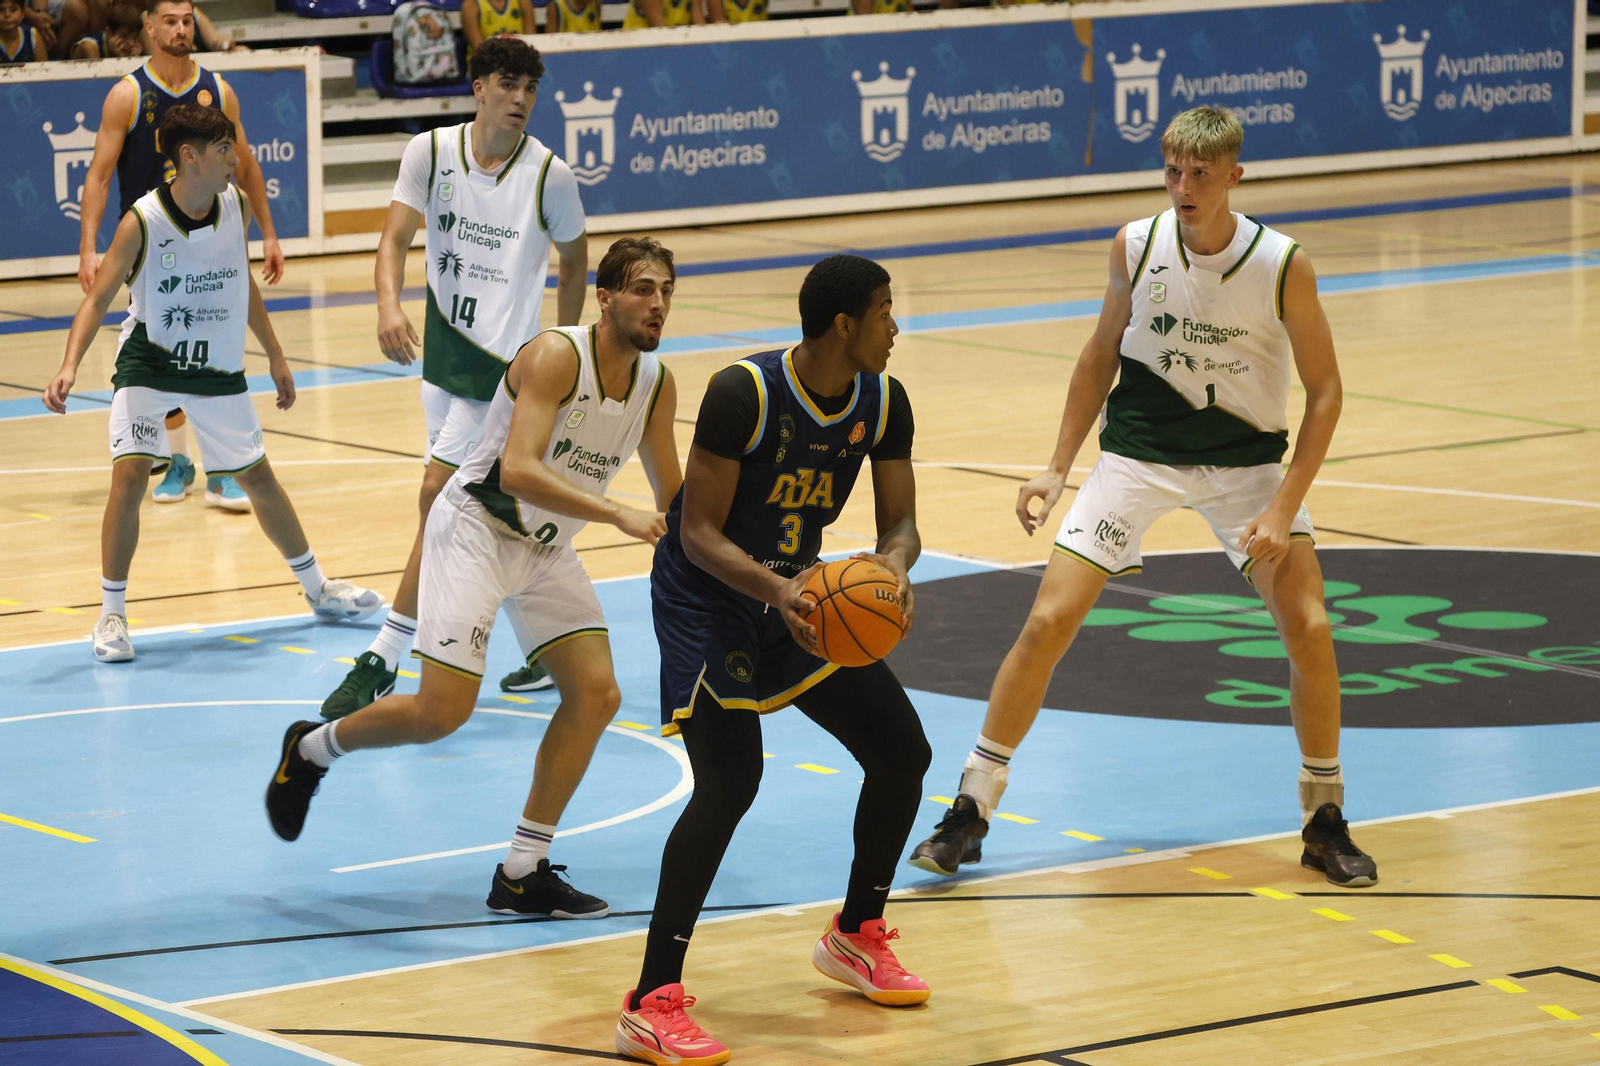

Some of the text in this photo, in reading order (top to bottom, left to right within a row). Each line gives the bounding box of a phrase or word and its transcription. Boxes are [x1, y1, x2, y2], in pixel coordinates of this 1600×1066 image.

[1435, 47, 1564, 83] Ayuntamiento
[1171, 66, 1308, 103] Ayuntamiento
[1434, 80, 1553, 113] de Algeciras
[922, 85, 1065, 122] Ayuntamiento
[629, 106, 780, 144] Ayuntamiento
[922, 118, 1052, 153] de Algeciras
[629, 141, 767, 176] de Algeciras
[457, 229, 501, 251] Unicaja
[459, 217, 520, 240] Fundación
[185, 267, 238, 284] Fundación
[468, 271, 509, 284] de la Torre
[450, 293, 478, 329] 14
[169, 339, 210, 370] 44
[1204, 383, 1217, 406] 1
[809, 443, 829, 452] vive
[777, 512, 804, 556] 3
